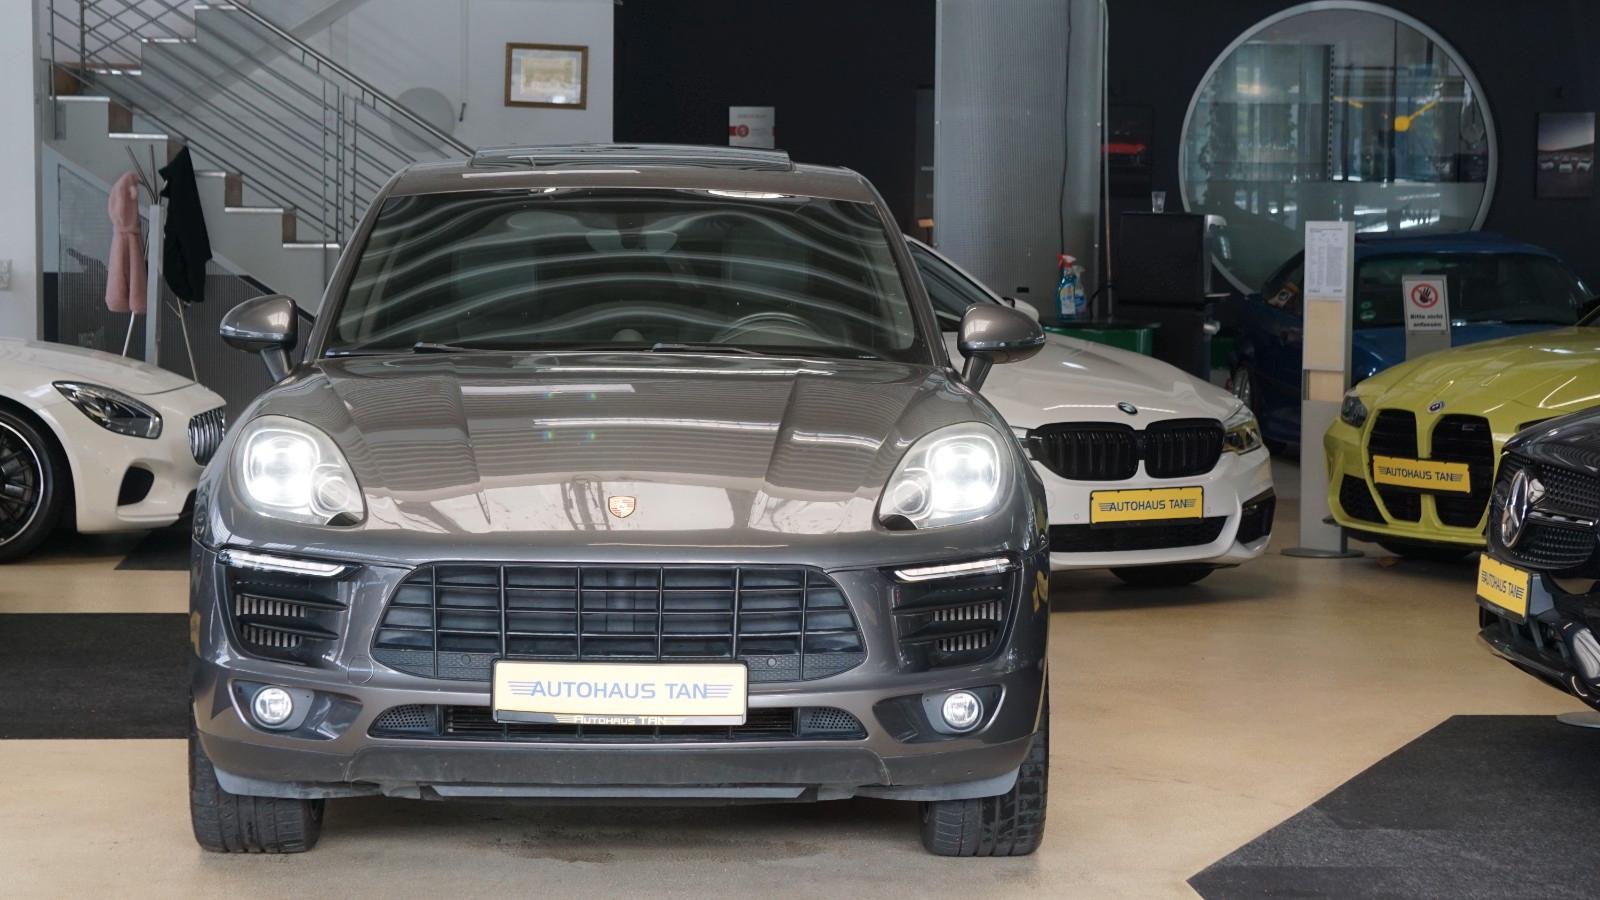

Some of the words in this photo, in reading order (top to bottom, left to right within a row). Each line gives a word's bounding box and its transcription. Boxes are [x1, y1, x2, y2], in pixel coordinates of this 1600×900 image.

[1385, 466, 1432, 480] AUTOHAUS
[1435, 471, 1454, 482] TAN
[1109, 500, 1165, 511] AUTOHAUS
[1168, 499, 1187, 509] TAN
[531, 681, 656, 699] AUTOHAUS
[665, 683, 708, 699] TAN
[639, 715, 665, 726] TAN
